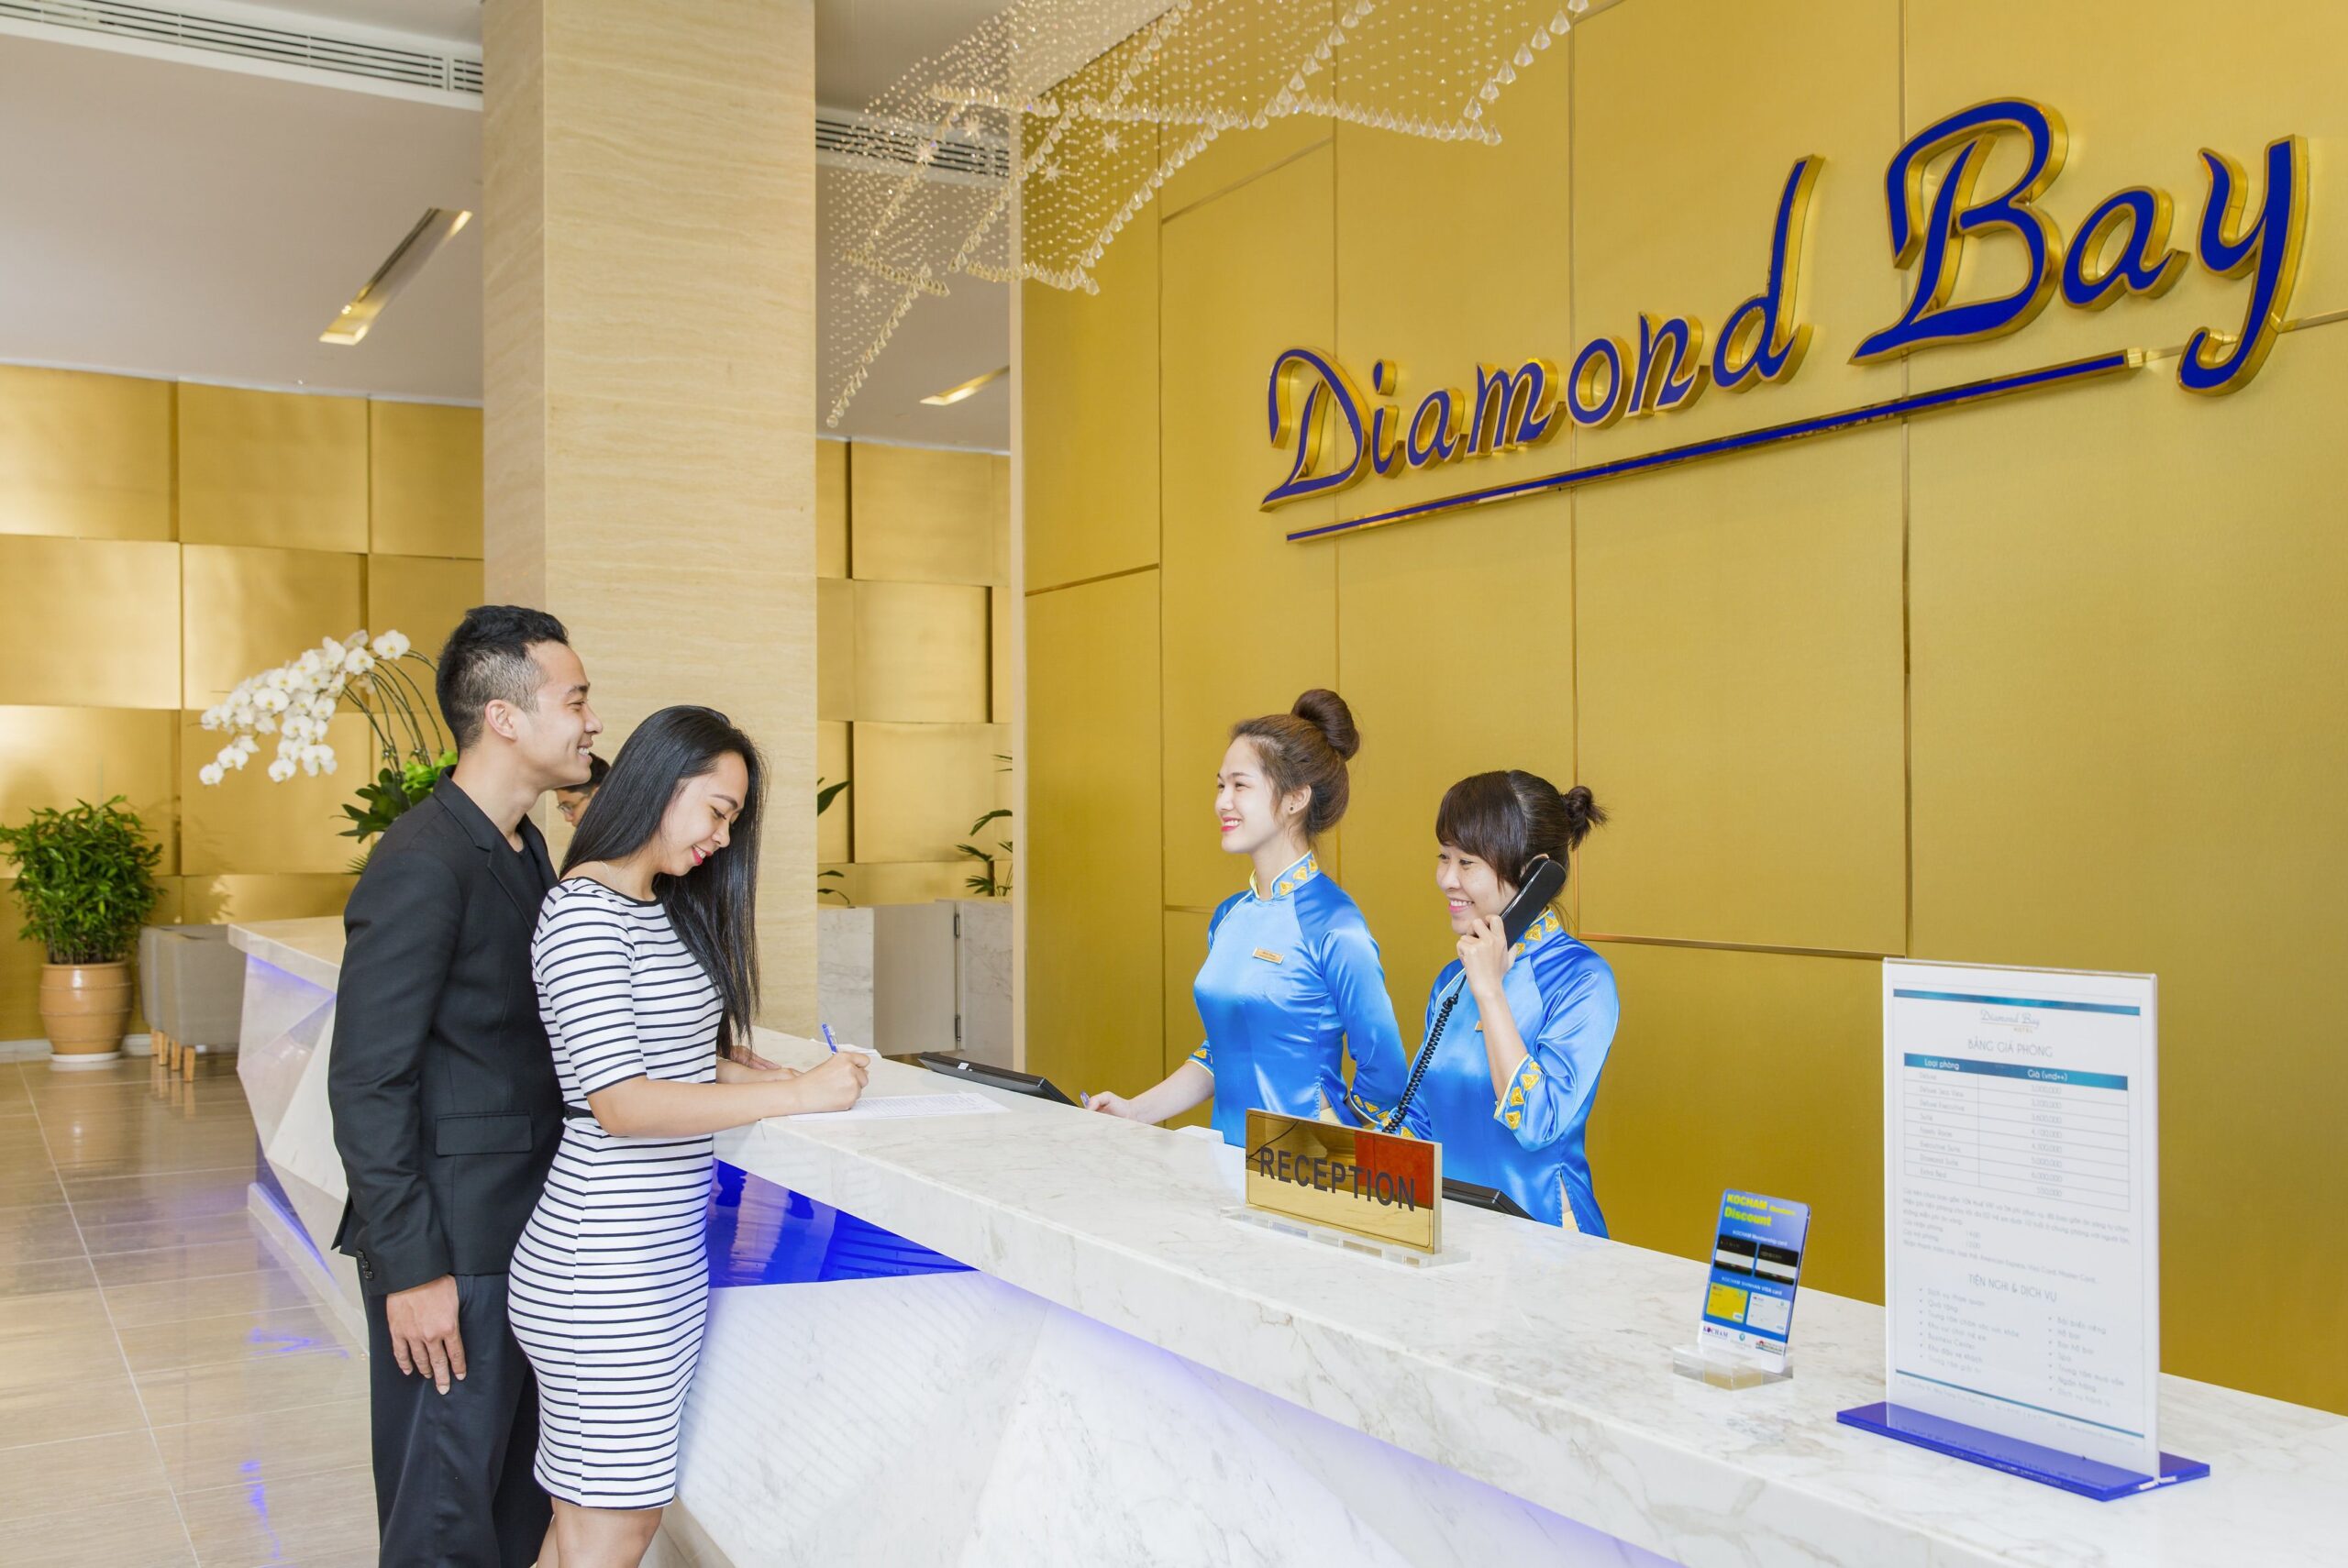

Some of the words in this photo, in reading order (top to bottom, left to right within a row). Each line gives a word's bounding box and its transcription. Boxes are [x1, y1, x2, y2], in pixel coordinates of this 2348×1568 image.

[1260, 152, 1825, 513] Diamond
[1847, 95, 2308, 398] Bay
[1980, 1009, 2019, 1023] Diamond
[2021, 1012, 2039, 1029] Bay
[1259, 1145, 1415, 1212] RECEPTION
[1726, 1193, 1768, 1210] KOCHAM
[1723, 1206, 1772, 1227] Discount
